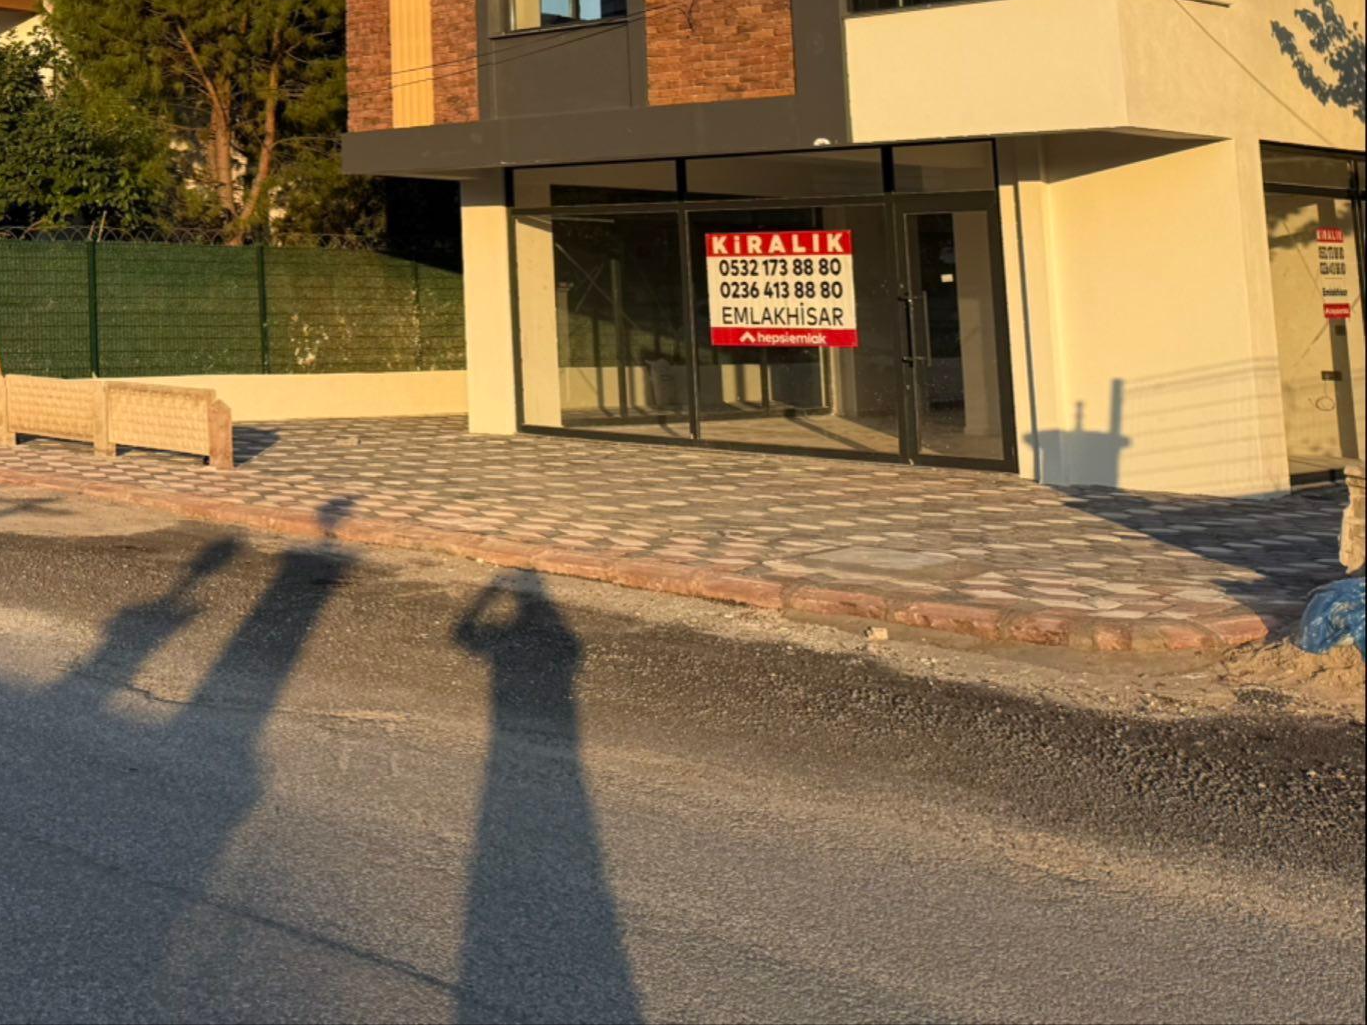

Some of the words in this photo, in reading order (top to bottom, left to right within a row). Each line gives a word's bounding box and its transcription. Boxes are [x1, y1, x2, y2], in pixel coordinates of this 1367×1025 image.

[719, 259, 759, 276] 0532
[763, 259, 788, 276] 173
[792, 258, 814, 276] 88
[818, 257, 842, 275] 80
[720, 281, 759, 299] 0236
[764, 281, 789, 299] 413
[794, 281, 816, 298] 88
[820, 281, 843, 298] 80
[757, 331, 827, 346] hepsiemlak
